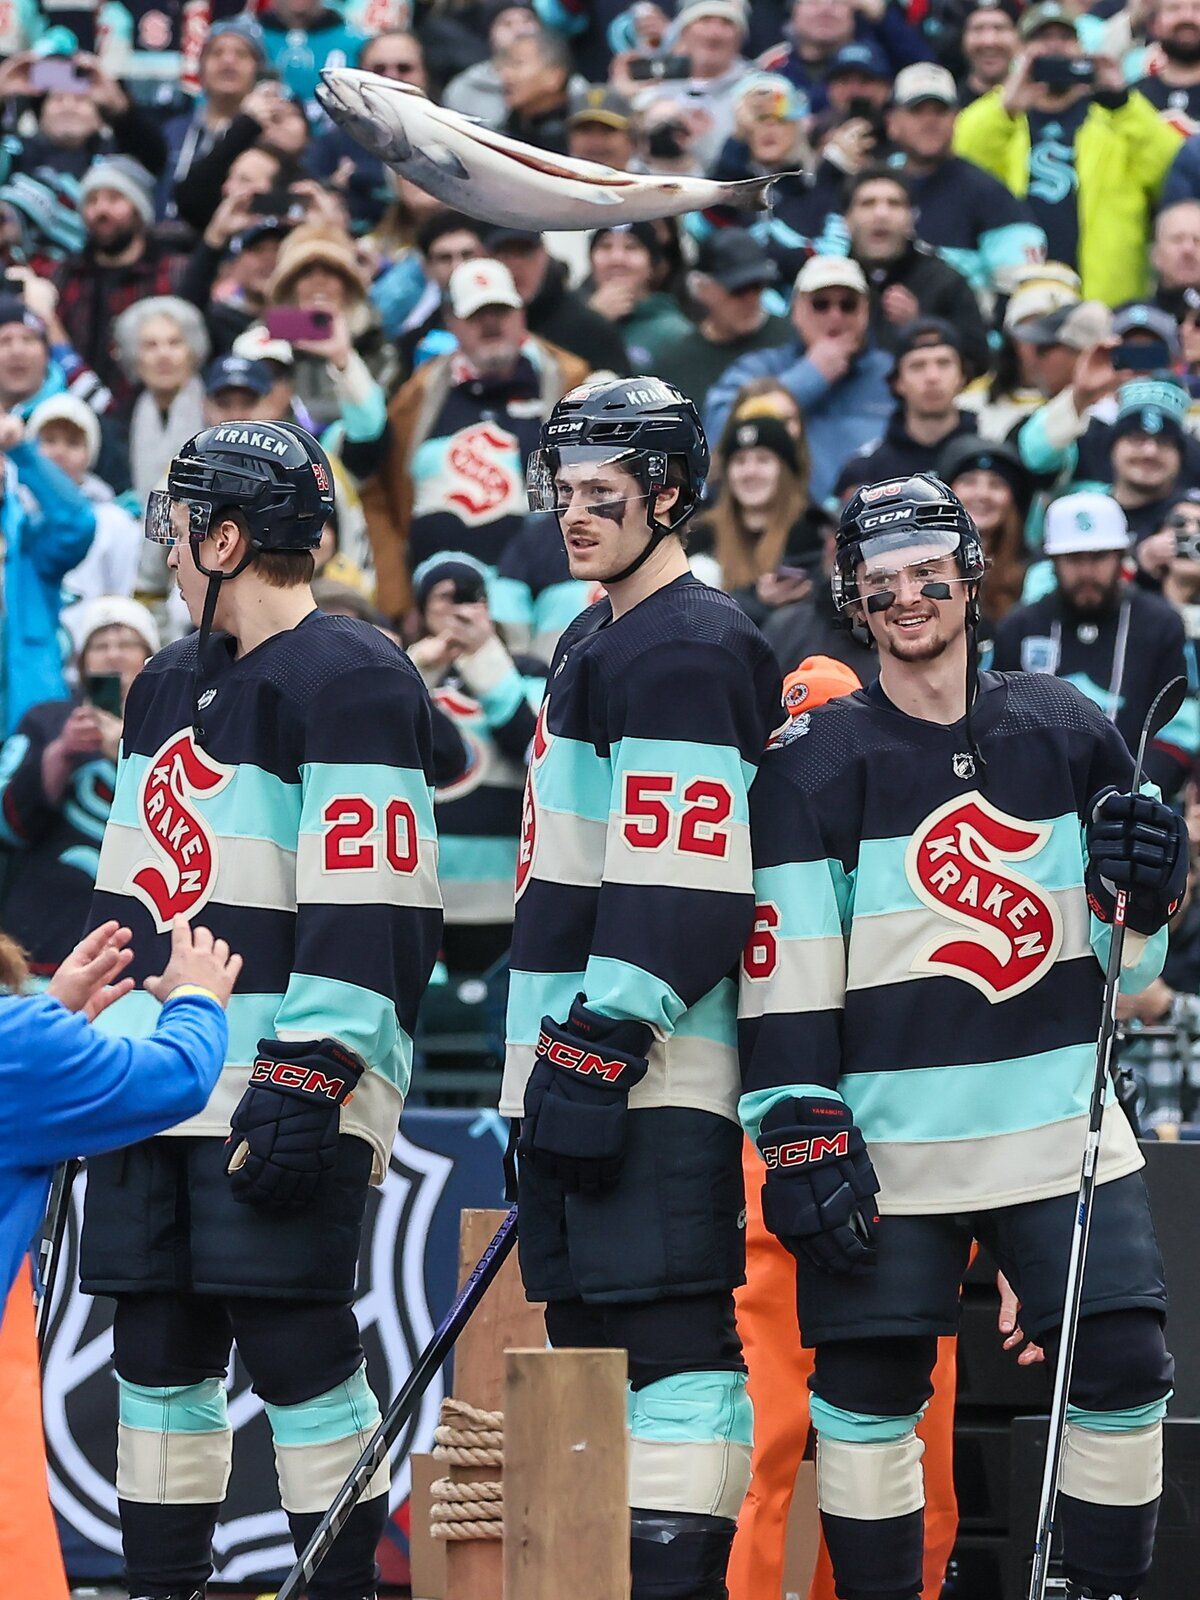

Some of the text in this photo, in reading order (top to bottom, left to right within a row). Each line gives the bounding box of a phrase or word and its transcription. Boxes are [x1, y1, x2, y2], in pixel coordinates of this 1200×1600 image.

[215, 428, 289, 457] KRAKEN
[547, 422, 584, 435] CCM
[864, 508, 912, 529] CCM
[147, 764, 203, 894] KRAKEN
[321, 794, 419, 876] 20
[620, 770, 735, 861] 52
[925, 834, 1046, 960] KRAKEN
[250, 1060, 345, 1100] CCM
[763, 1131, 849, 1170] CCM
